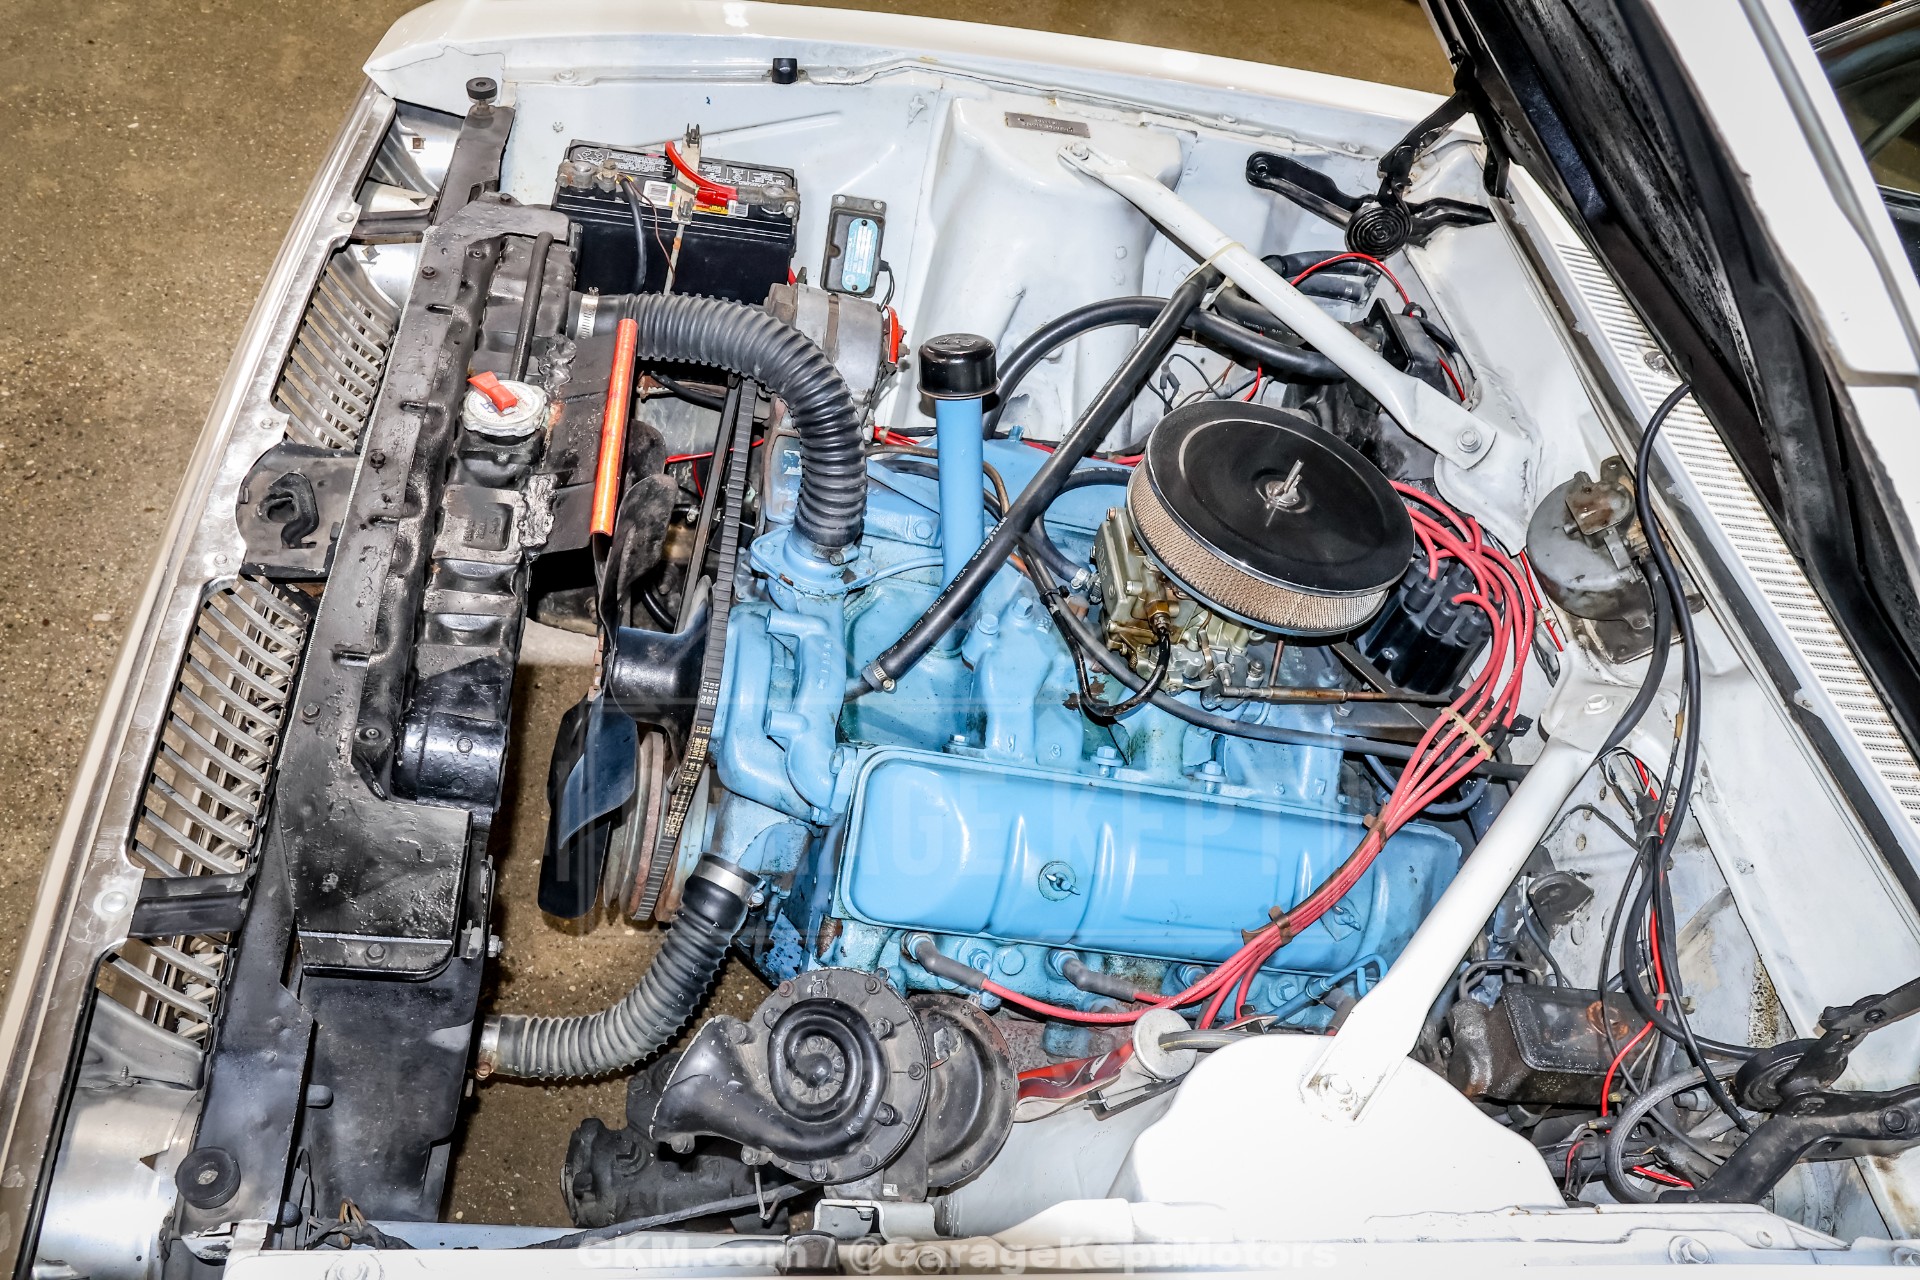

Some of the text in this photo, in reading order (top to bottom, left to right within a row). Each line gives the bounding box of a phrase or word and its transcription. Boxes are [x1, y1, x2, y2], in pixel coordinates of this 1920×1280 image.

[927, 594, 946, 614] MADE
[946, 584, 955, 593] IN
[954, 568, 969, 582] USA
